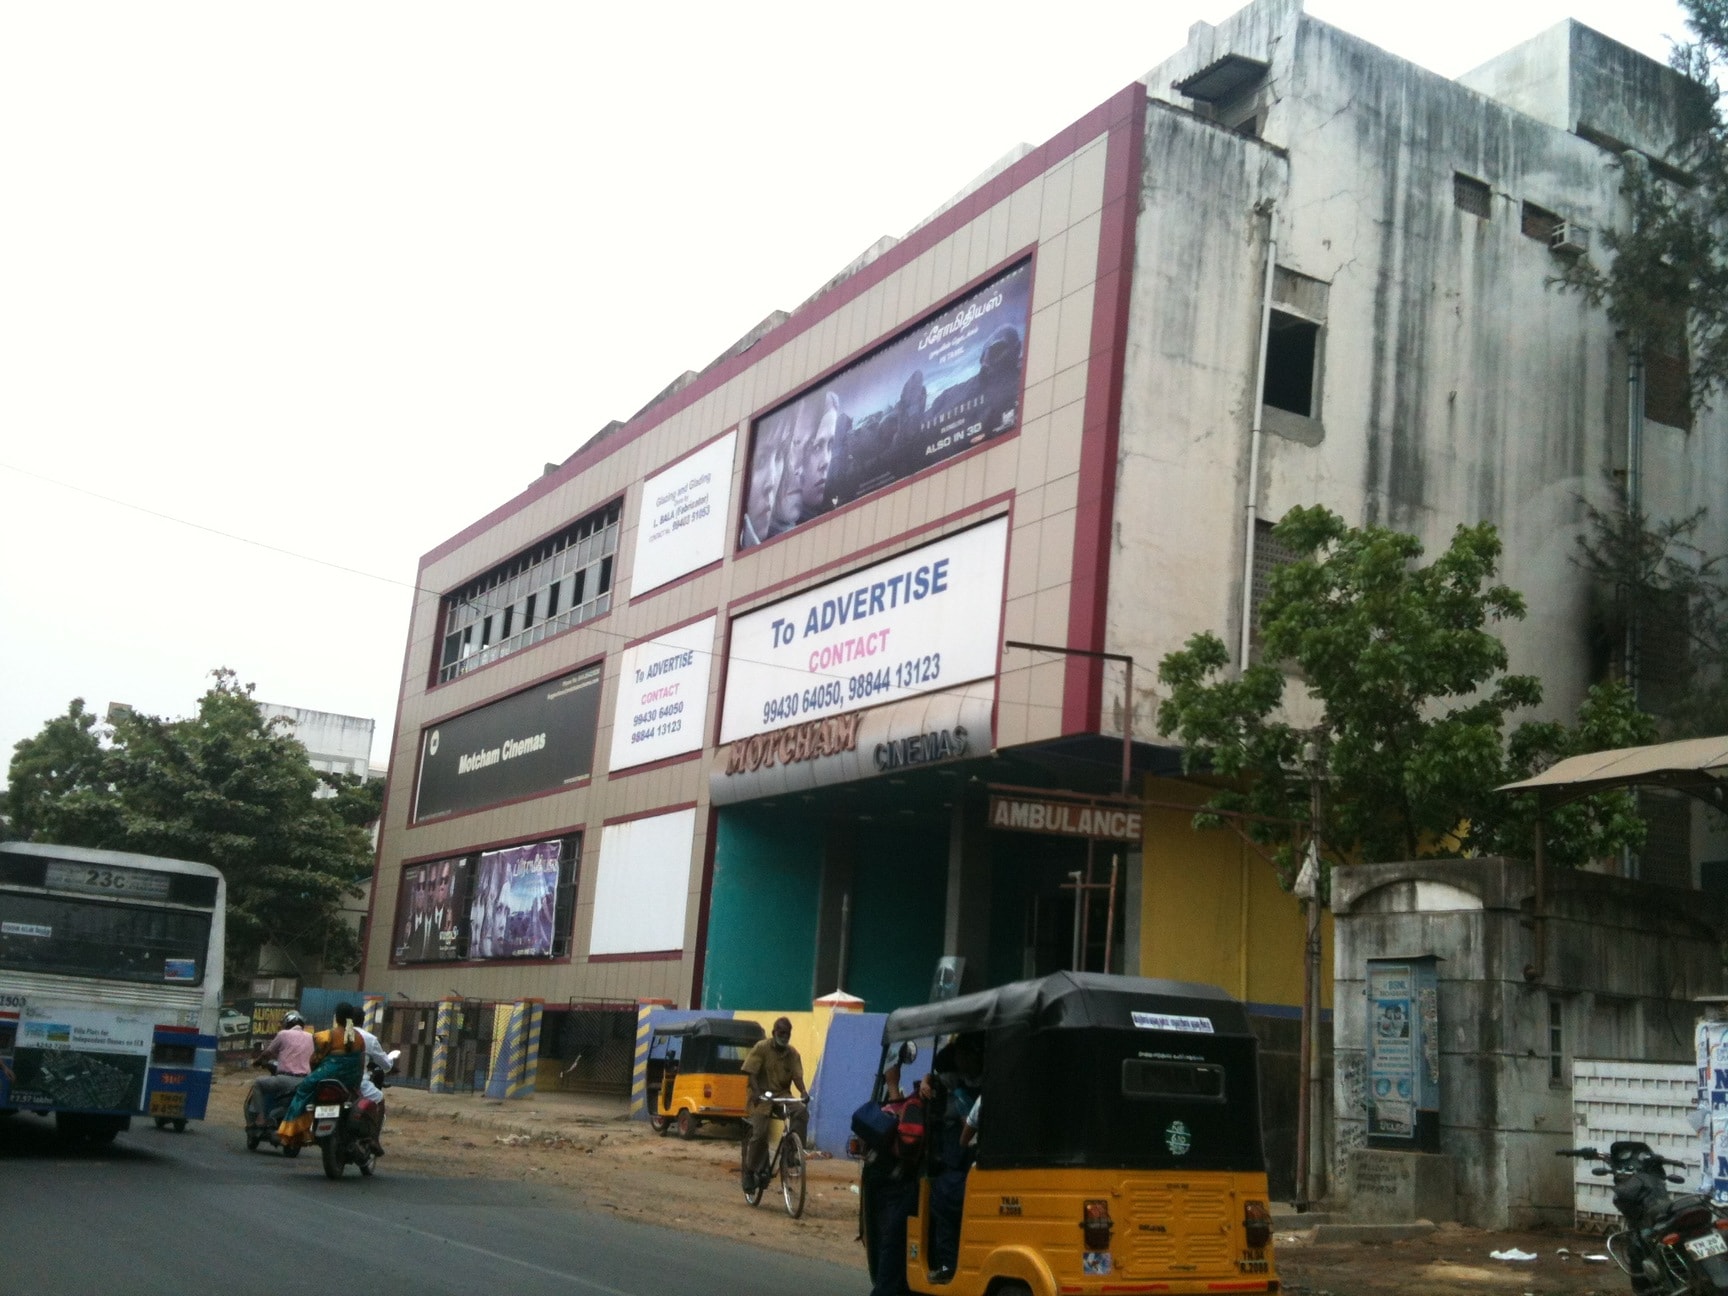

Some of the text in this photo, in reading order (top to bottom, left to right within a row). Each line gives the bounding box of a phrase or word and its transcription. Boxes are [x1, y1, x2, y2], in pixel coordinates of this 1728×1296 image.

[925, 436, 952, 456] ALSO
[953, 430, 966, 443] IN
[967, 421, 983, 437] 3D
[660, 510, 674, 525] BALA
[771, 558, 950, 649] To ADVERTISE
[635, 649, 694, 684] To ADVERTISE
[808, 628, 890, 673] CONTACT
[640, 683, 680, 705] CONTACT
[763, 652, 941, 725] 99430 64050, 98844 13123
[631, 719, 682, 744] 98844 13123
[633, 701, 684, 727] 99430 64050
[458, 732, 546, 775] Motcham Cinemas
[725, 712, 969, 776] MOTCHAM CINEMAS
[994, 799, 1142, 838] AMBULANCE
[85, 869, 126, 889] 23C
